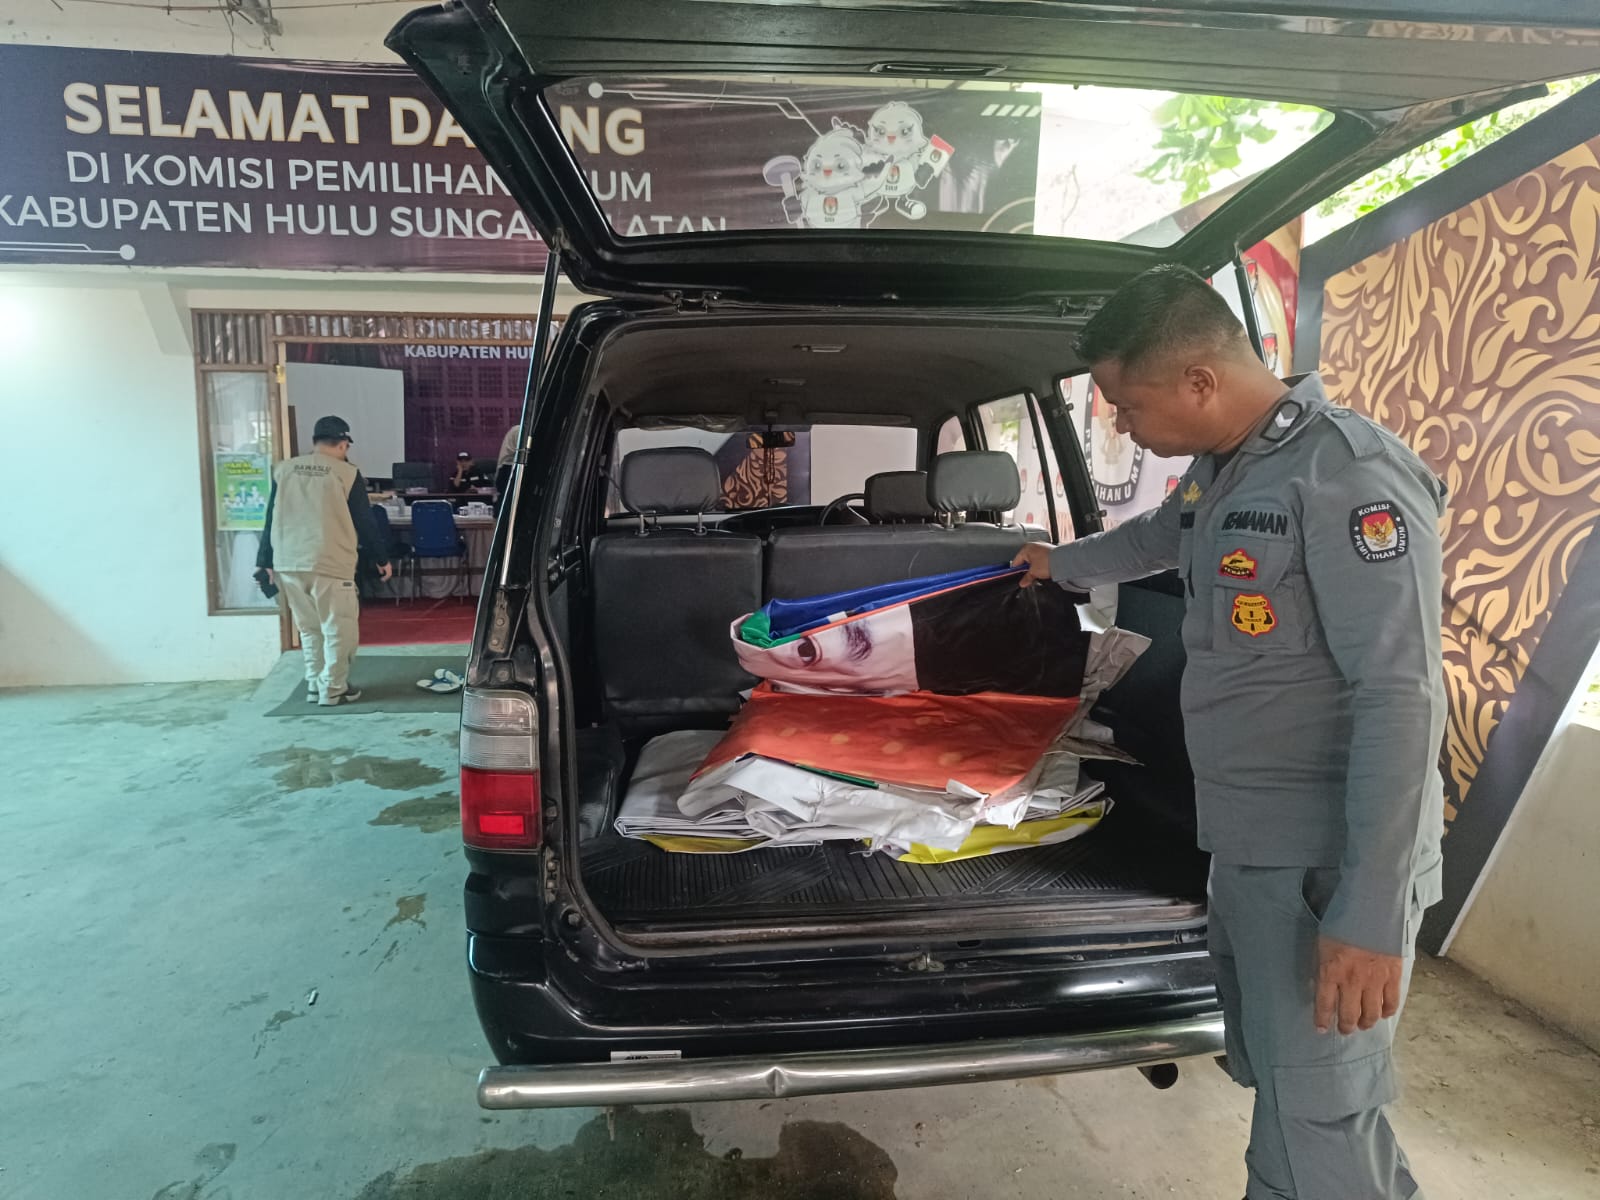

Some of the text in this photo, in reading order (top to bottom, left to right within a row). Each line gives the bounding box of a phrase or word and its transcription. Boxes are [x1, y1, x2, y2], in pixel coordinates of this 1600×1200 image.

[63, 82, 645, 157] SELAMAT DANG
[66, 150, 110, 184] DI
[124, 153, 274, 189] KOMISI
[288, 159, 512, 196] PEMILIHAN
[0, 194, 251, 234] KABUPATEN
[265, 203, 378, 236] HULU
[390, 206, 545, 240] SUNGA
[404, 344, 501, 359] KABUPATEN
[1358, 503, 1391, 517] KOMISI
[1353, 534, 1396, 560] PEMILIHAN
[1398, 526, 1407, 552] UMUM
